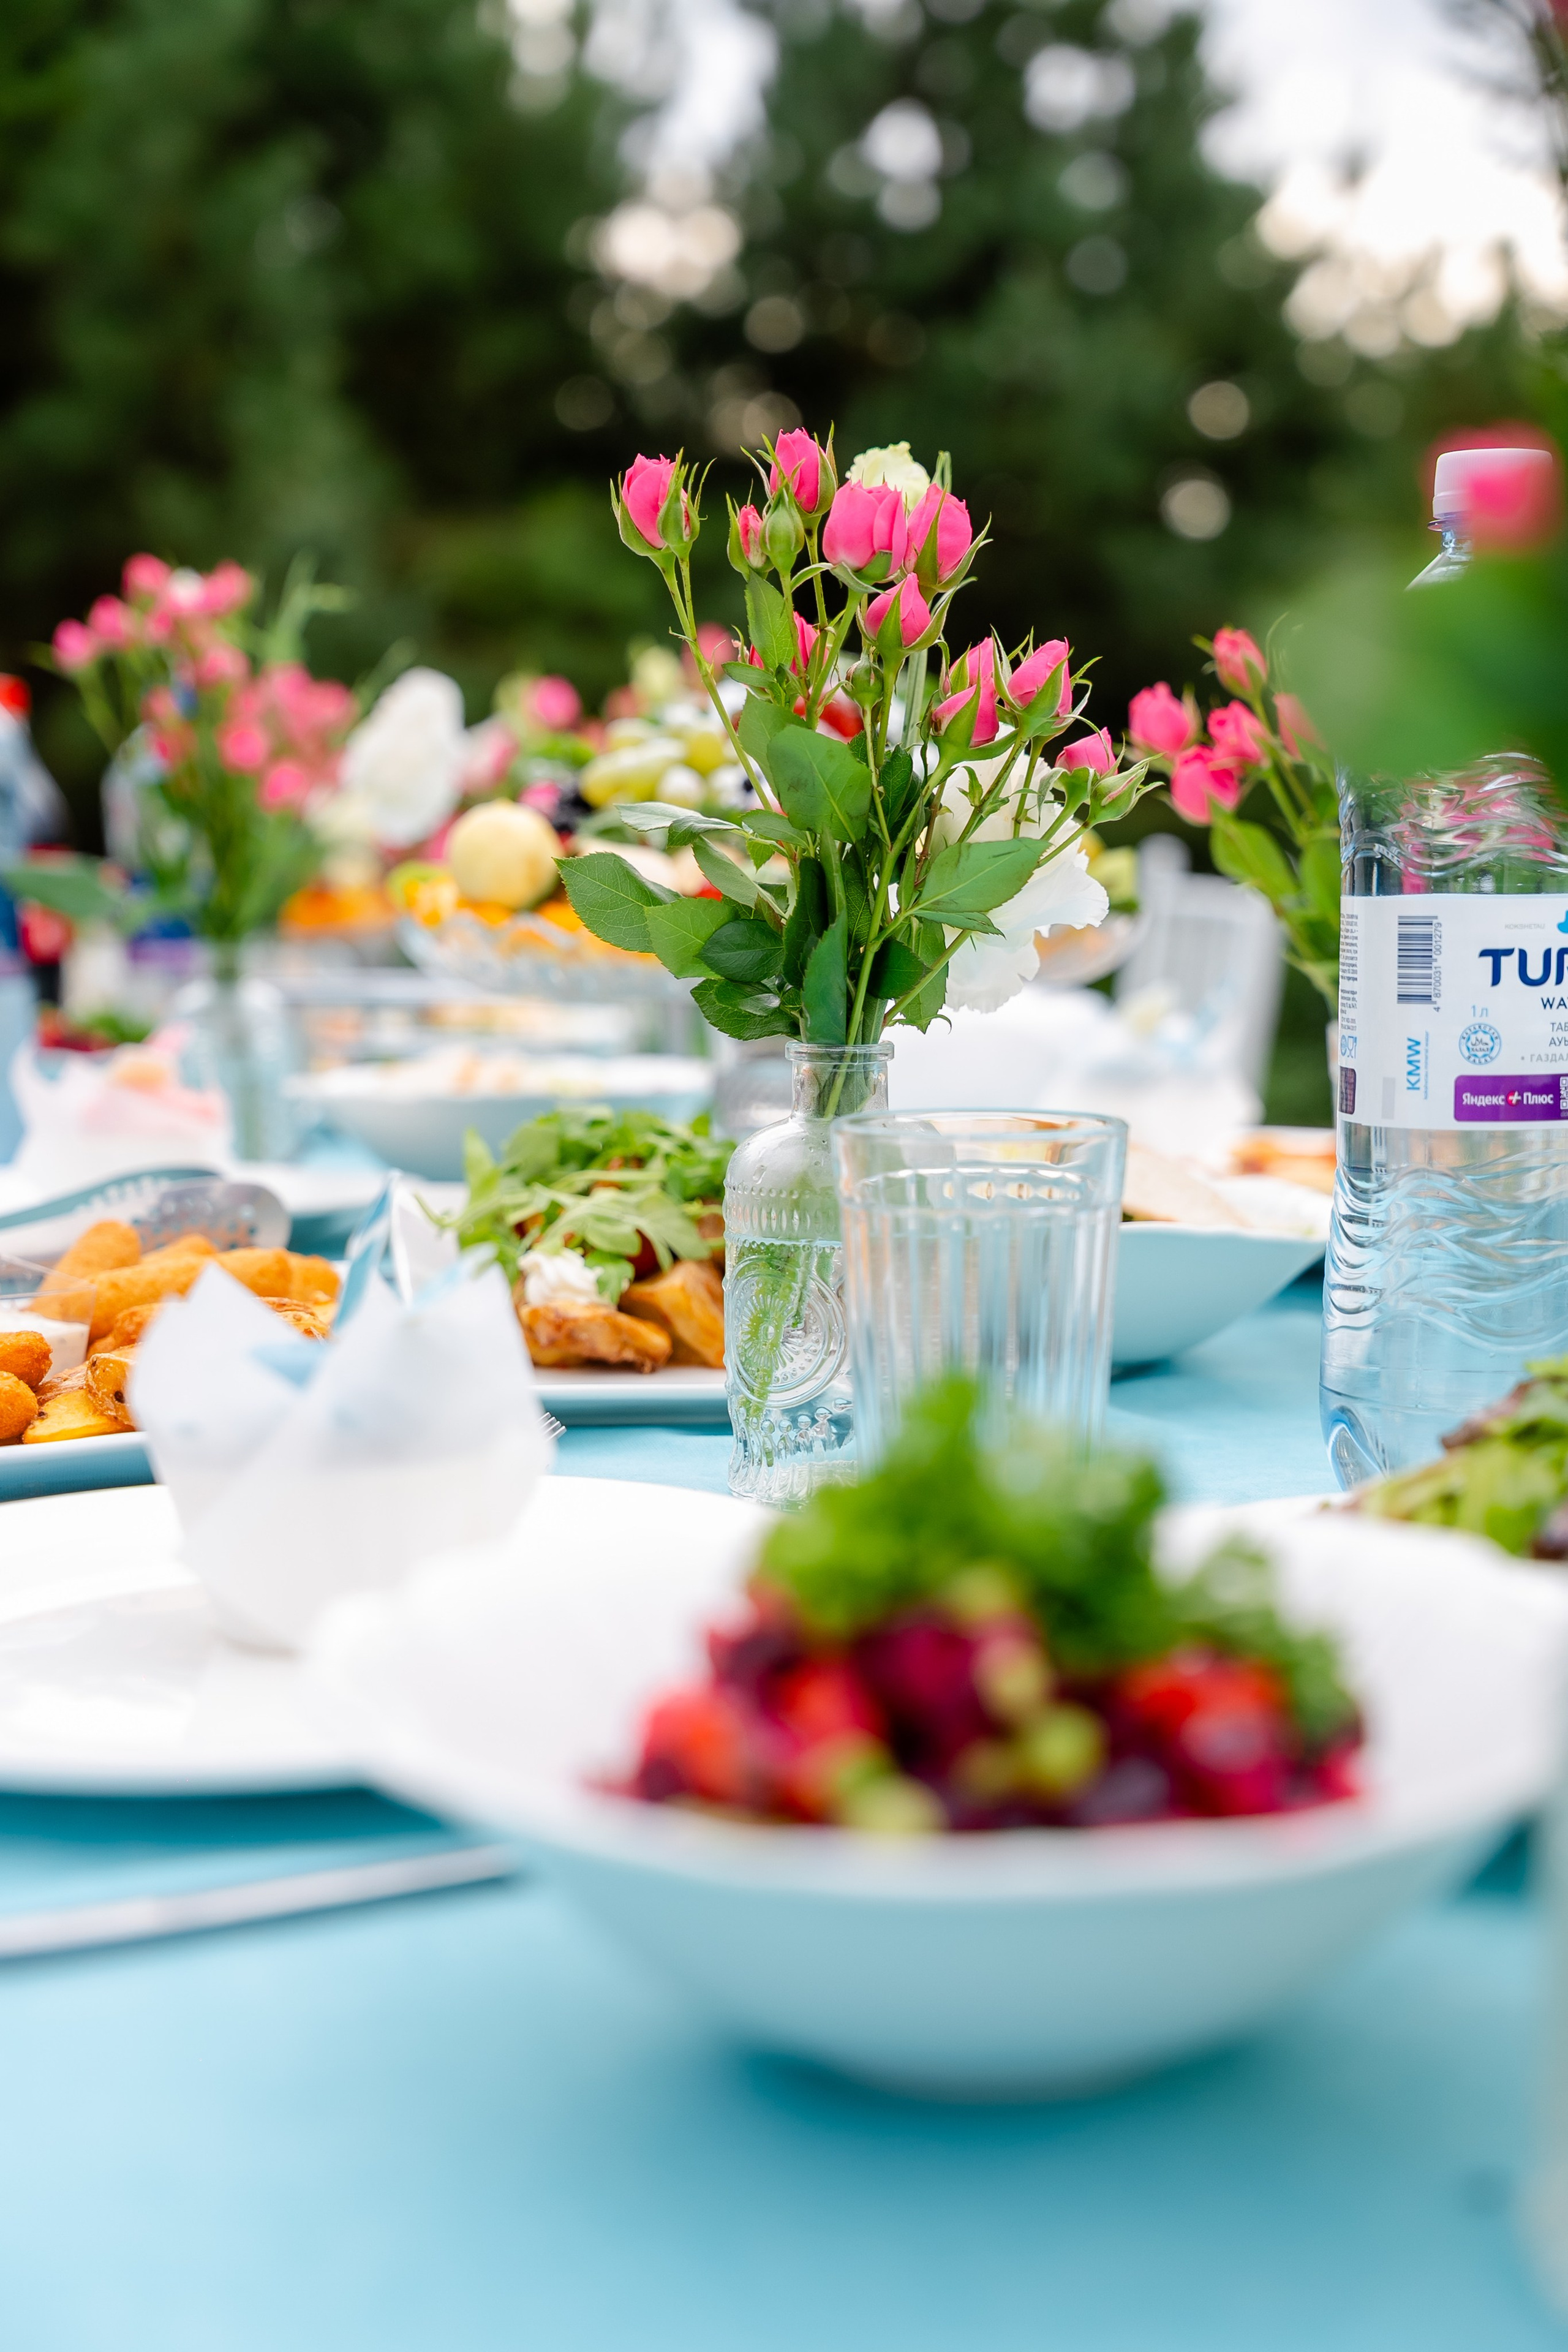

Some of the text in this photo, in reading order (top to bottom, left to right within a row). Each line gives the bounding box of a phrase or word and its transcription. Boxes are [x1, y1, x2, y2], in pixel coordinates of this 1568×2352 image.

[1541, 997, 1568, 1010] WA
[1407, 1038, 1420, 1090] KMW
[1463, 1092, 1554, 1107] Яндекс Плюс
